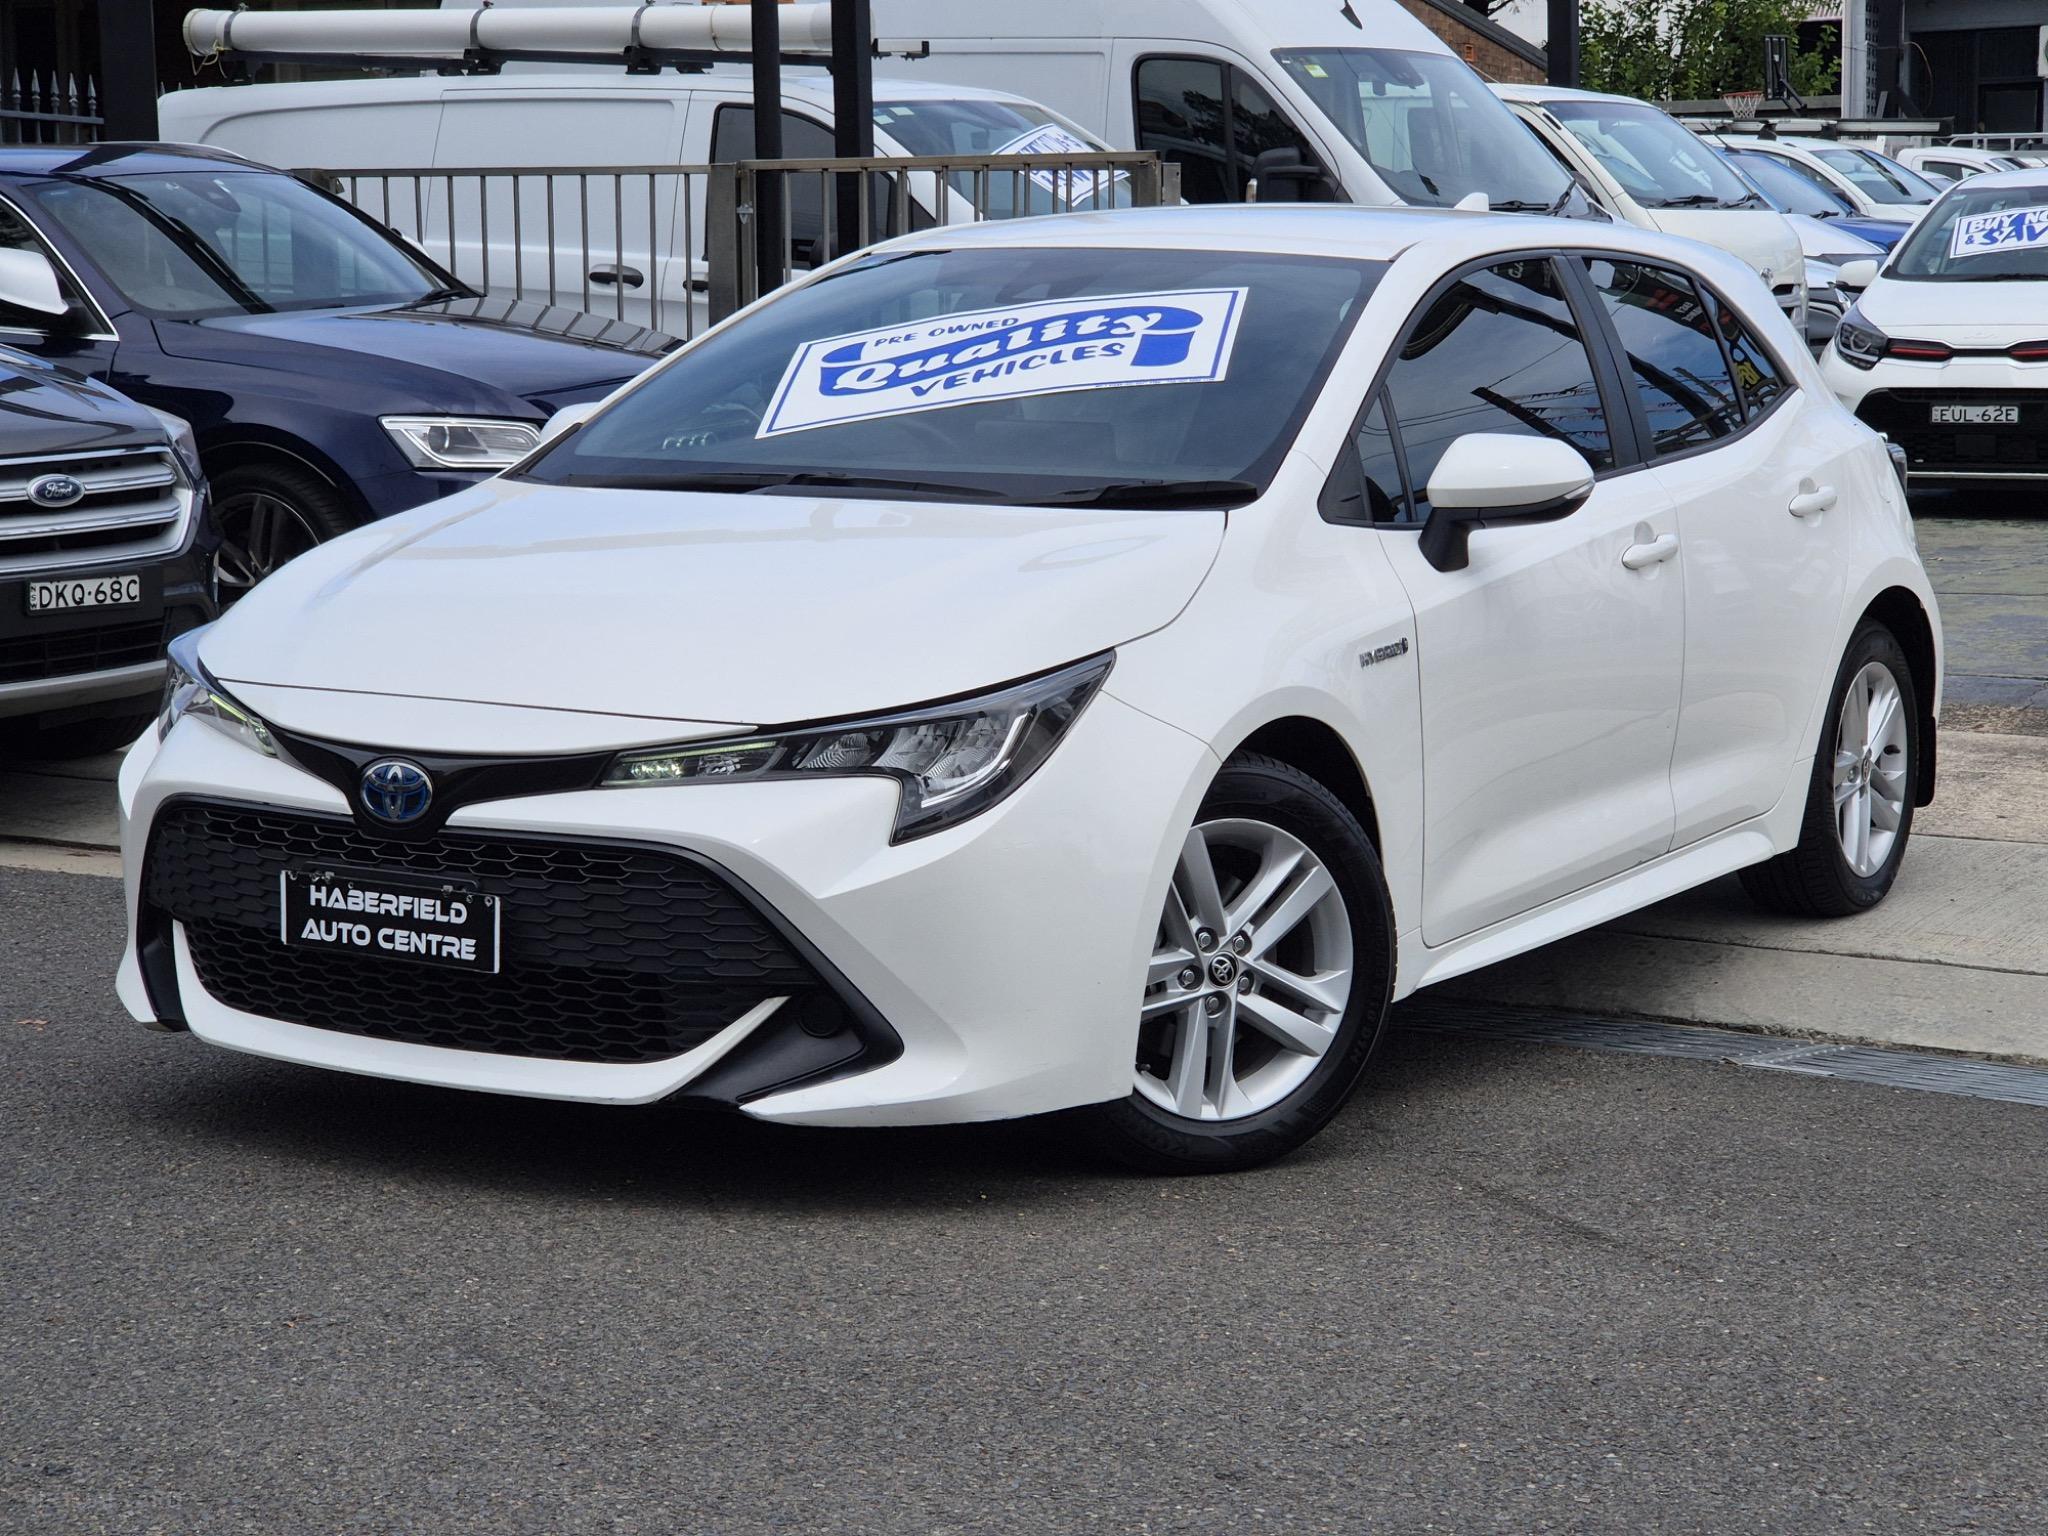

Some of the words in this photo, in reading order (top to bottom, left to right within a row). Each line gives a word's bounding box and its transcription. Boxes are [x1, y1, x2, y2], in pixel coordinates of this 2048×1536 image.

[1967, 212, 2016, 234] BUY
[1965, 235, 1976, 246] &
[873, 332, 914, 347] PRE
[933, 317, 1019, 337] OWNED
[833, 311, 1164, 390] Quality
[911, 342, 1125, 397] VEHICLES
[45, 482, 72, 498] Ford
[309, 885, 468, 924] HABERFIELD
[301, 918, 371, 946] AUTO
[377, 928, 476, 961] CENTRE
